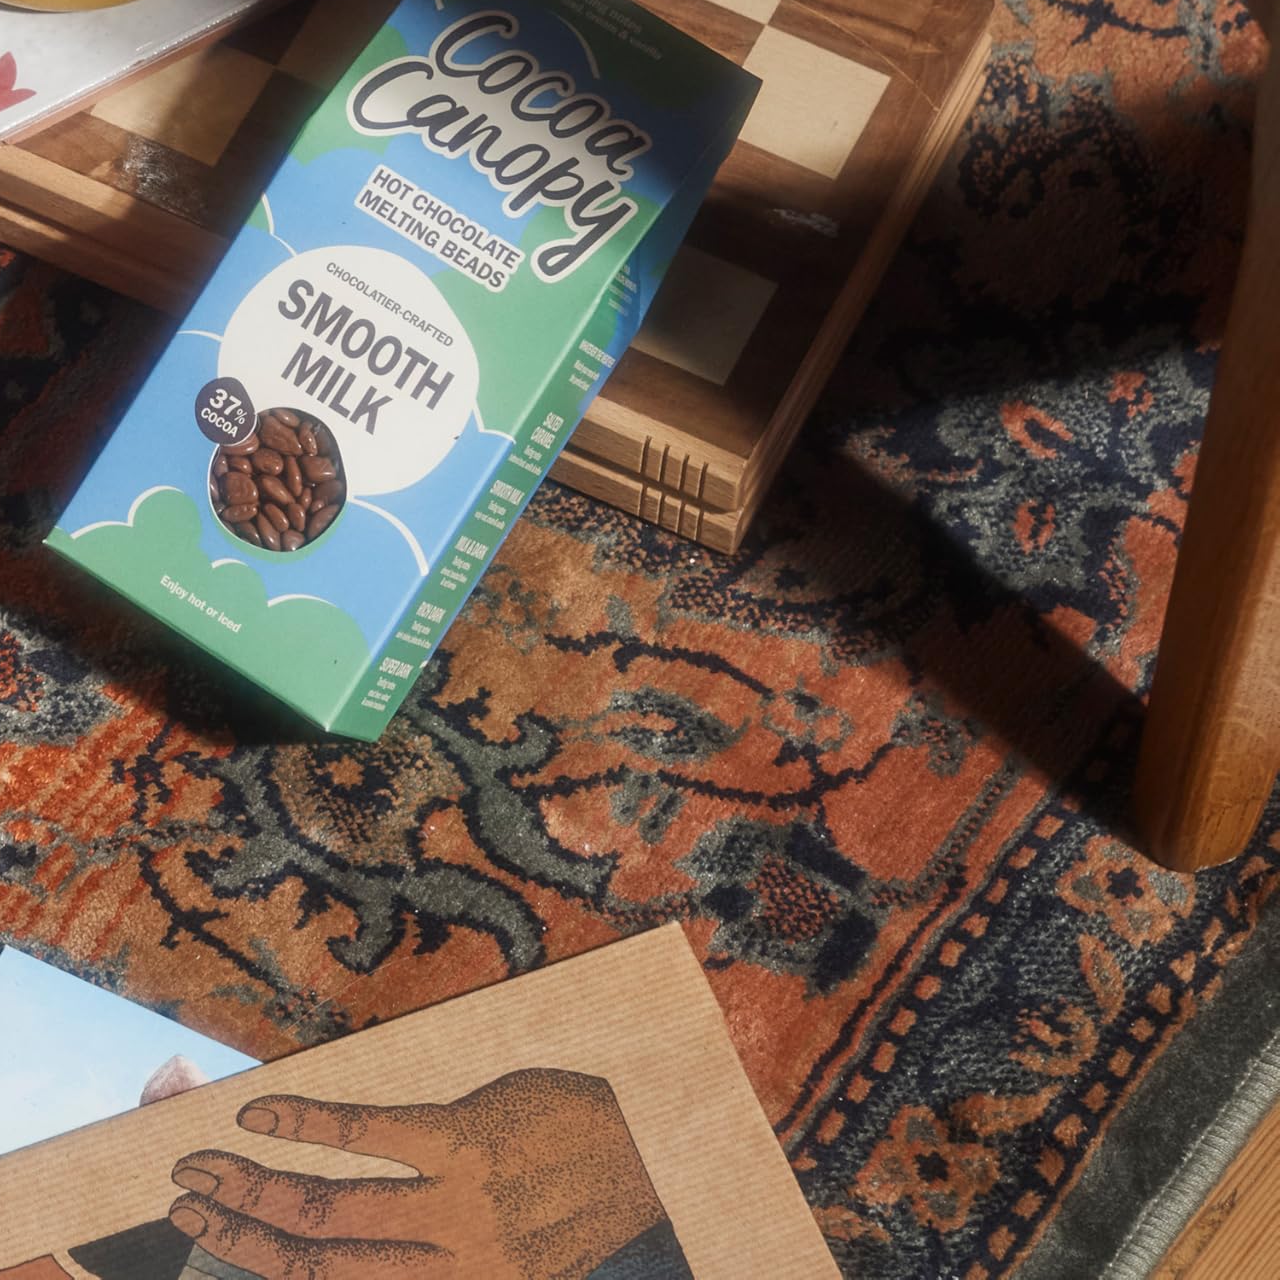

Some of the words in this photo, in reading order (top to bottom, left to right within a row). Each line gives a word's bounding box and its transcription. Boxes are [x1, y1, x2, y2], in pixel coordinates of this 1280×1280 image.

[434, 14, 647, 175] Cocoa
[352, 59, 633, 277] Canopy
[359, 189, 442, 248] MELTING
[439, 242, 506, 288] BEADS
[372, 169, 414, 200] HOT
[412, 193, 521, 269] CHOCOLATE
[277, 278, 455, 410] SMOOTH
[325, 261, 454, 347] CHOCOLATIER-CRAFTED
[200, 407, 239, 438] COCOA
[209, 388, 248, 425] 37%
[280, 341, 393, 435] MILK
[160, 574, 189, 600] Enjoy
[187, 593, 207, 611] hot
[206, 606, 219, 618] or
